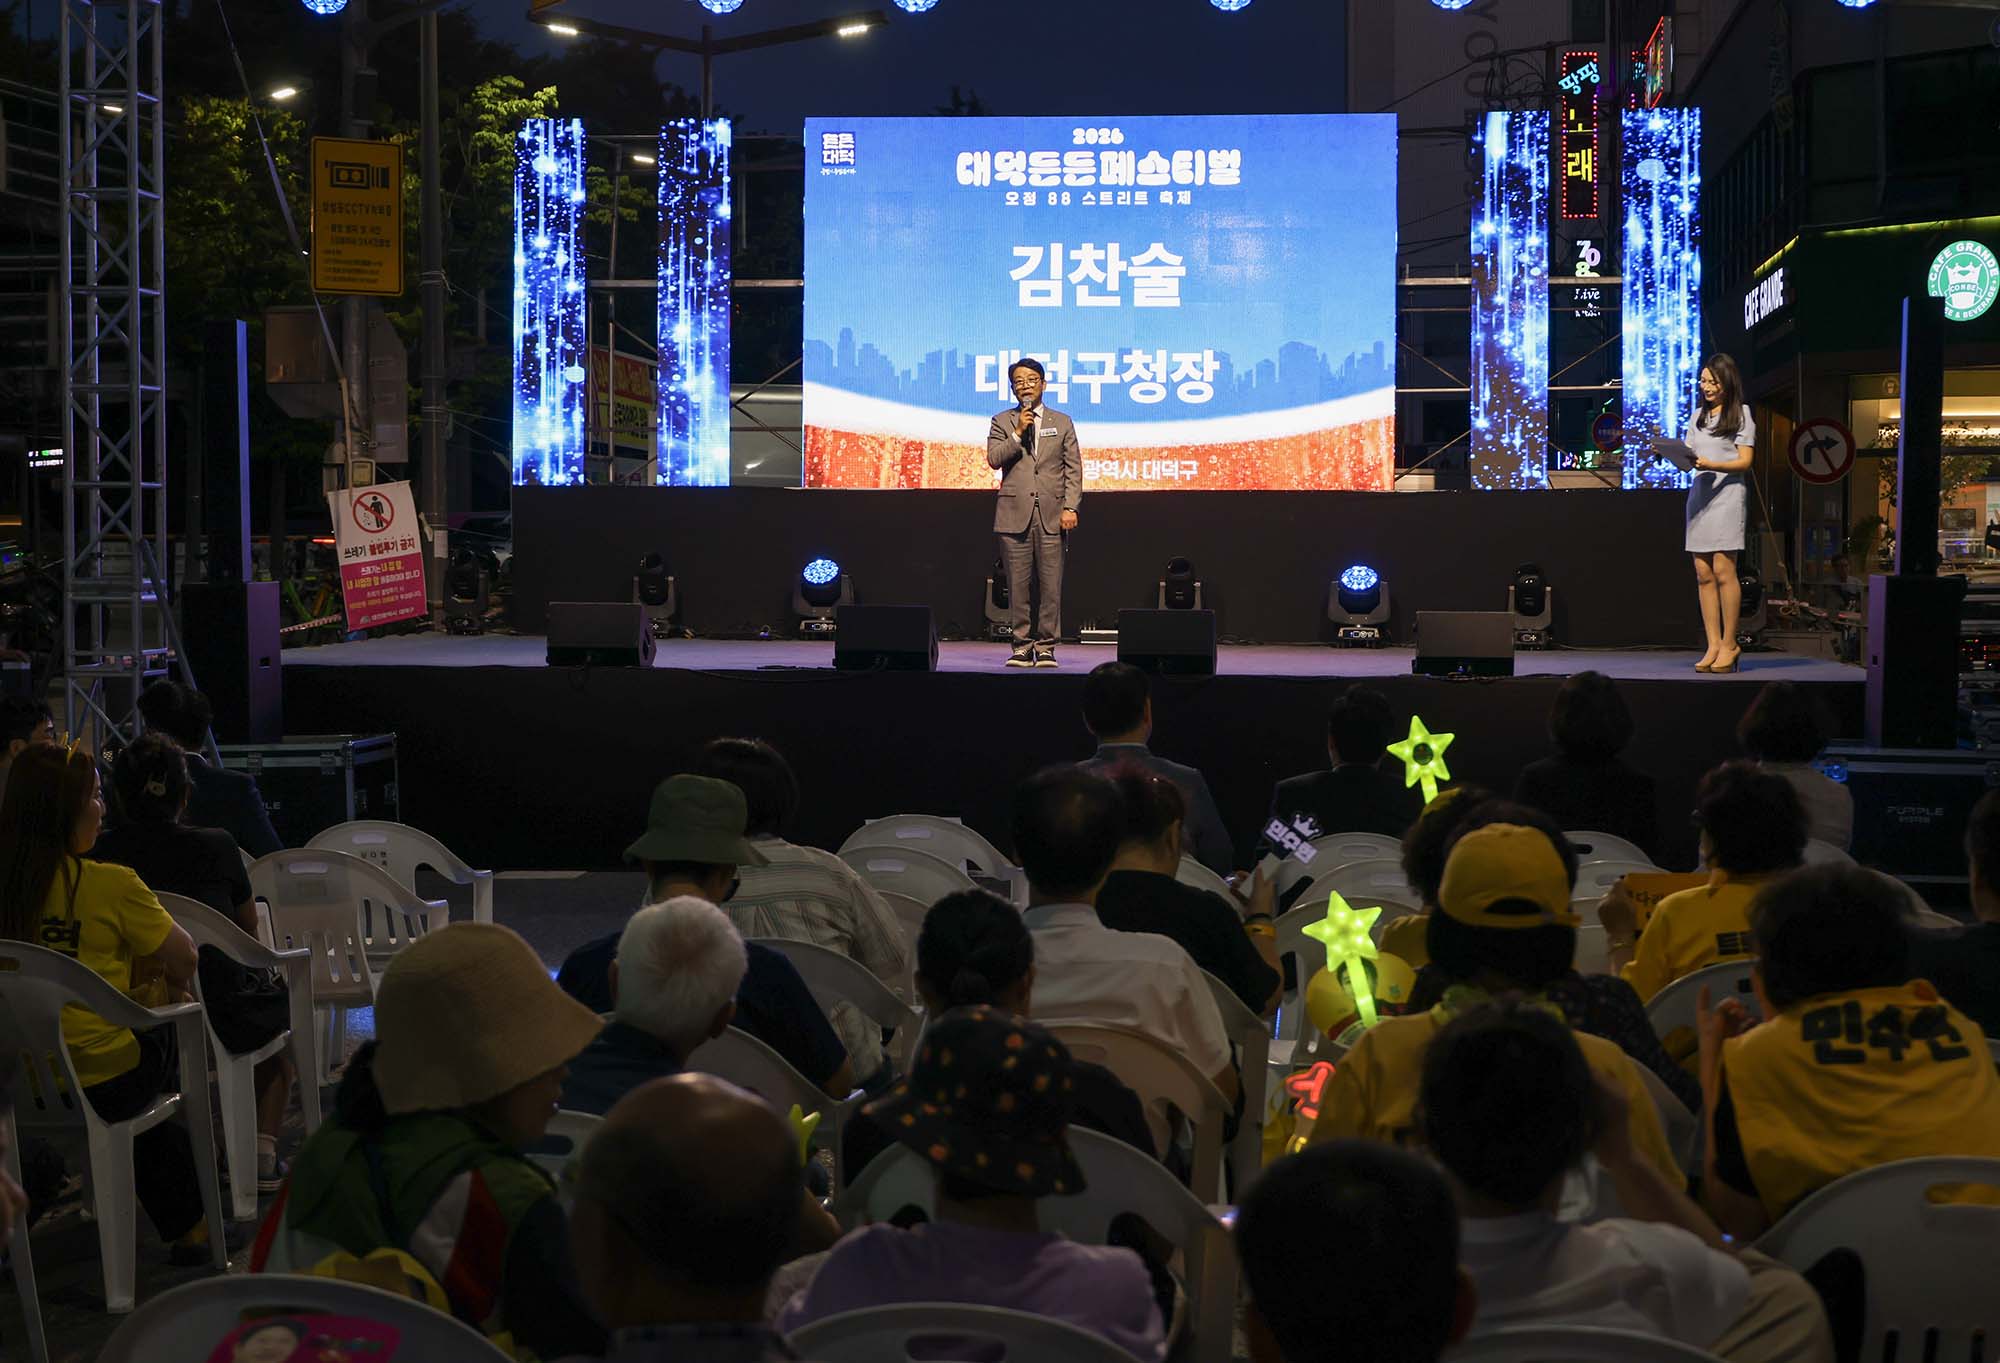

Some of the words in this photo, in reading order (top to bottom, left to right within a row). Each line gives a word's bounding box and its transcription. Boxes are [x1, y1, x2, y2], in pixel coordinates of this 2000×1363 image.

[1558, 61, 1600, 95] 팡팡
[1072, 128, 1124, 145] 2026
[822, 150, 855, 165] 대덕
[1005, 191, 1036, 206] 오정
[1047, 191, 1071, 205] 88
[1082, 191, 1148, 206] 스트리트
[1159, 191, 1191, 206] 축제
[1009, 243, 1187, 307] 김찬술
[1929, 247, 1953, 281] CAFE
[1956, 242, 1999, 277] GRANDE
[1744, 286, 1759, 330] CAFE
[1760, 267, 1783, 319] GRANDE
[1963, 286, 1996, 318] BEVERAGE
[975, 350, 1220, 404] 대덕구청장
[1083, 460, 1137, 480] 광역시
[1142, 460, 1198, 480] 대덕구
[344, 545, 366, 558] 쓰레기
[370, 541, 399, 556] 불법투기
[400, 538, 415, 550] 금지
